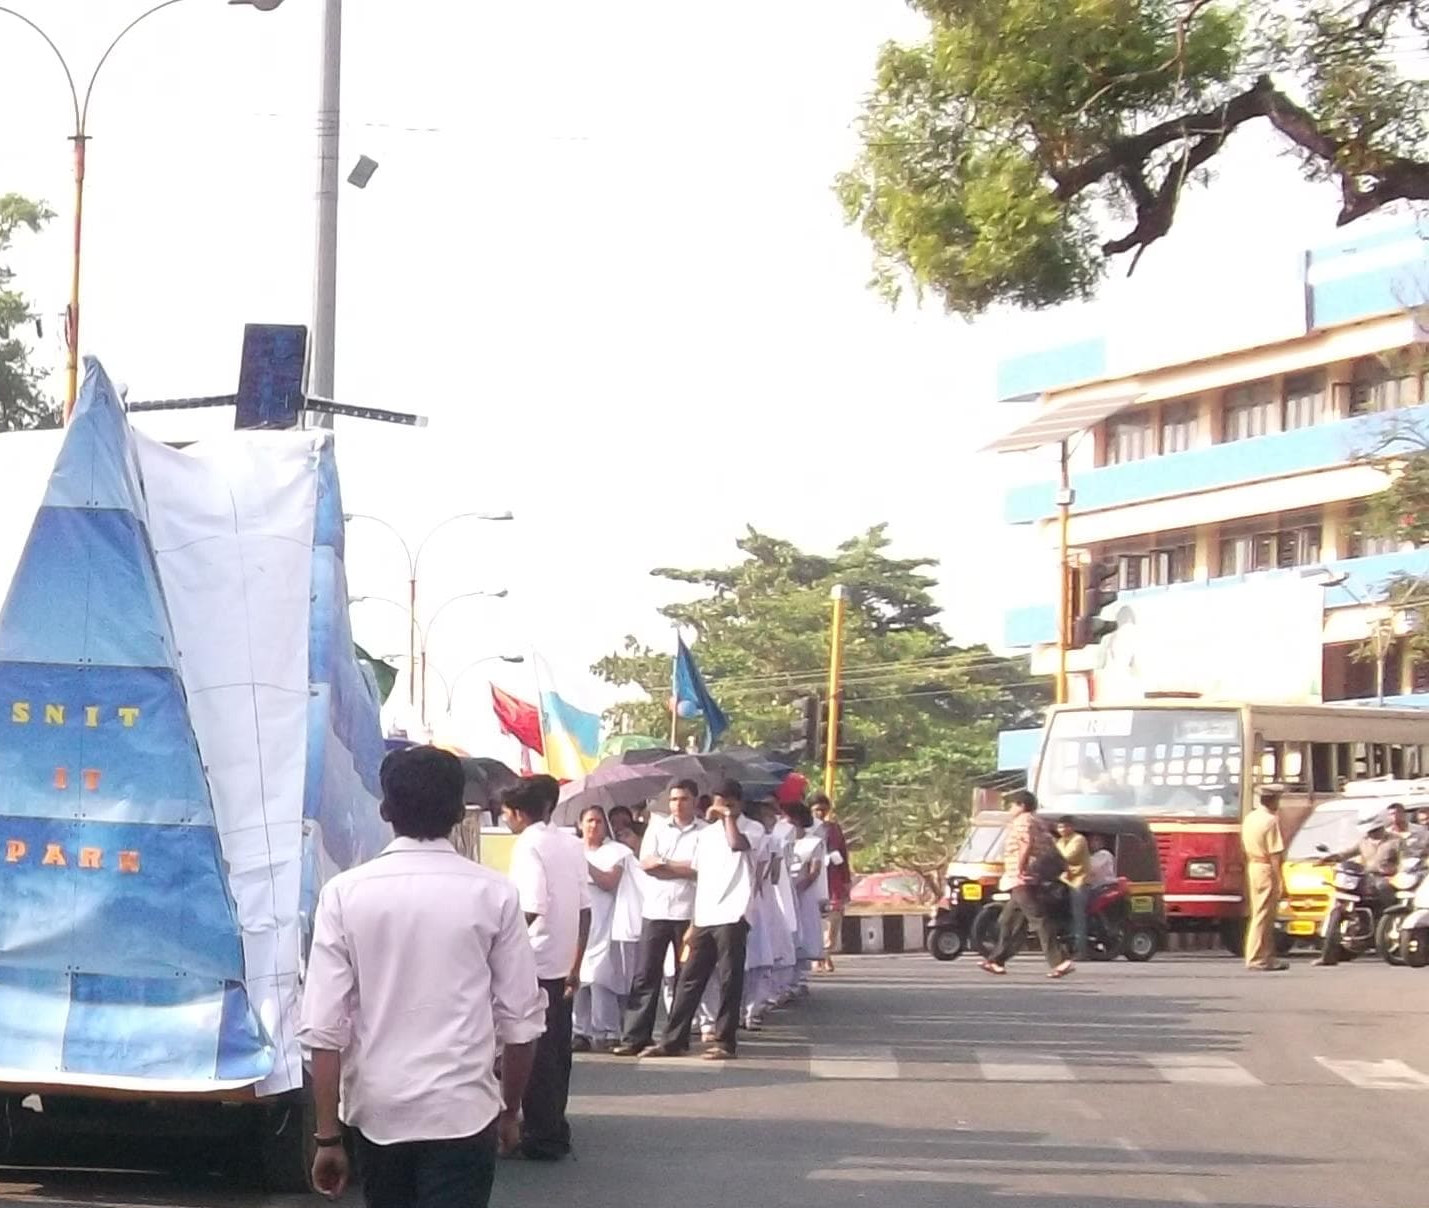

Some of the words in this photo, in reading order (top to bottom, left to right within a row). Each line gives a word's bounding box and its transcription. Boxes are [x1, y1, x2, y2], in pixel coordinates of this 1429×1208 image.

[12, 702, 140, 727] SNIT
[54, 766, 102, 791] IT
[5, 840, 141, 873] PARK
